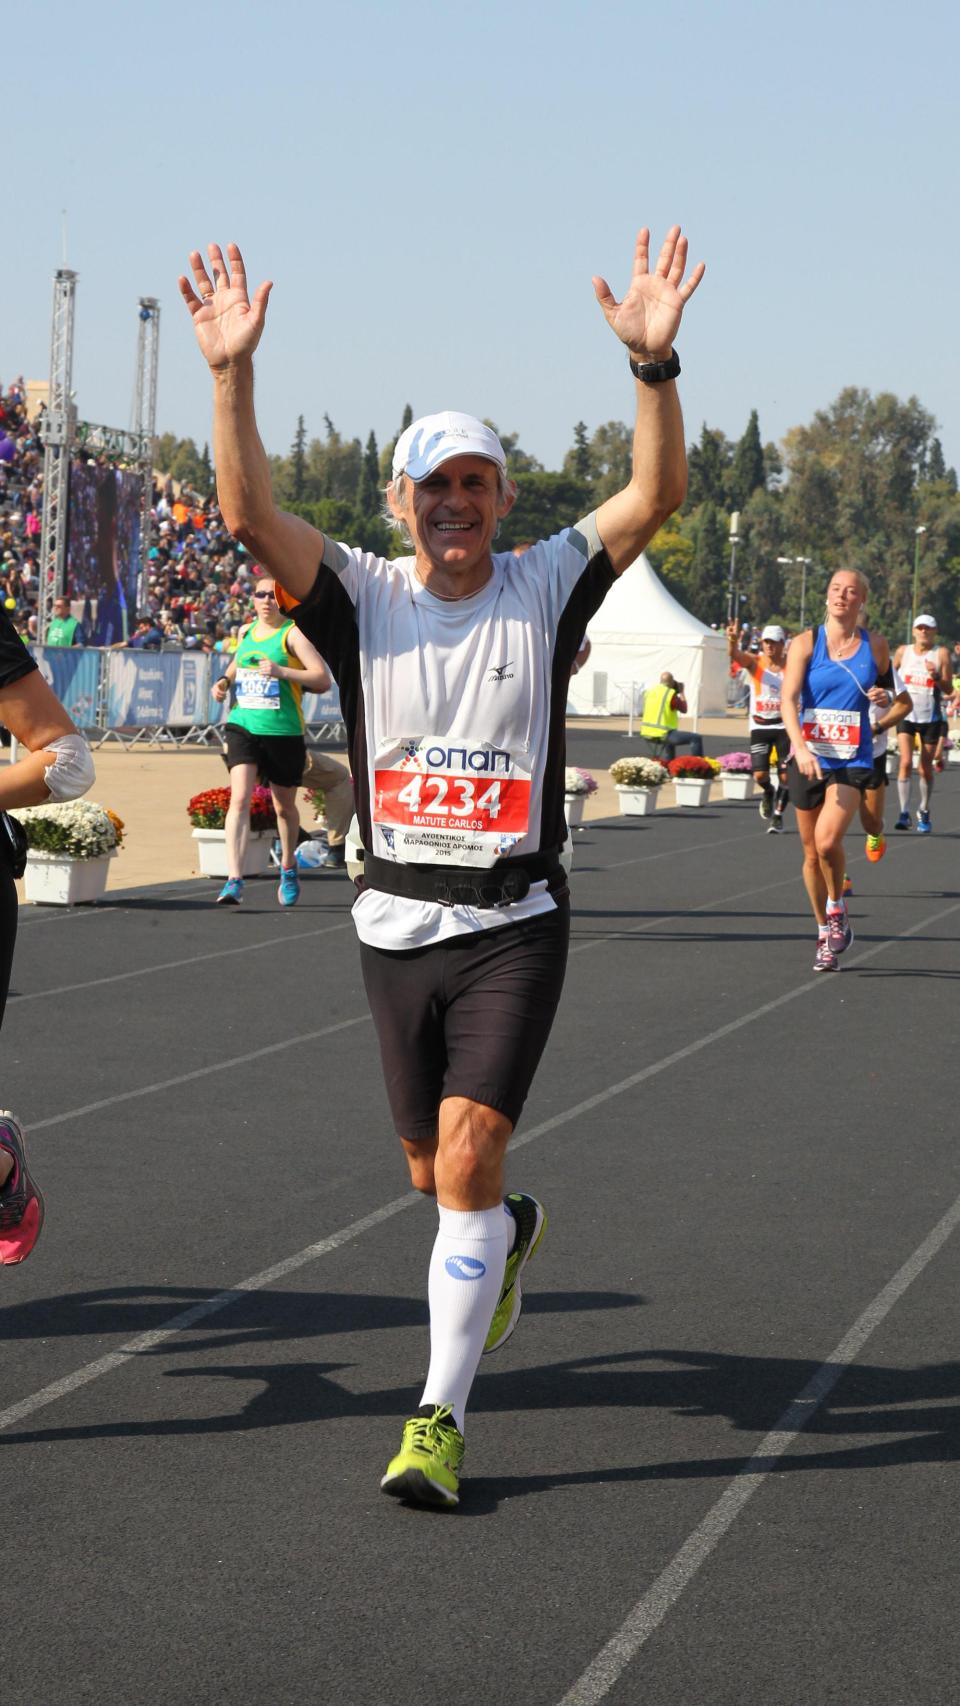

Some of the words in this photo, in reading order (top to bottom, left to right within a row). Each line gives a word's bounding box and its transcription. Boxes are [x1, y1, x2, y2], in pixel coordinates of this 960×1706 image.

[810, 723, 849, 740] 4363
[398, 775, 501, 818] 4234
[413, 815, 446, 827] MATUTE
[448, 818, 483, 829] CARLOS
